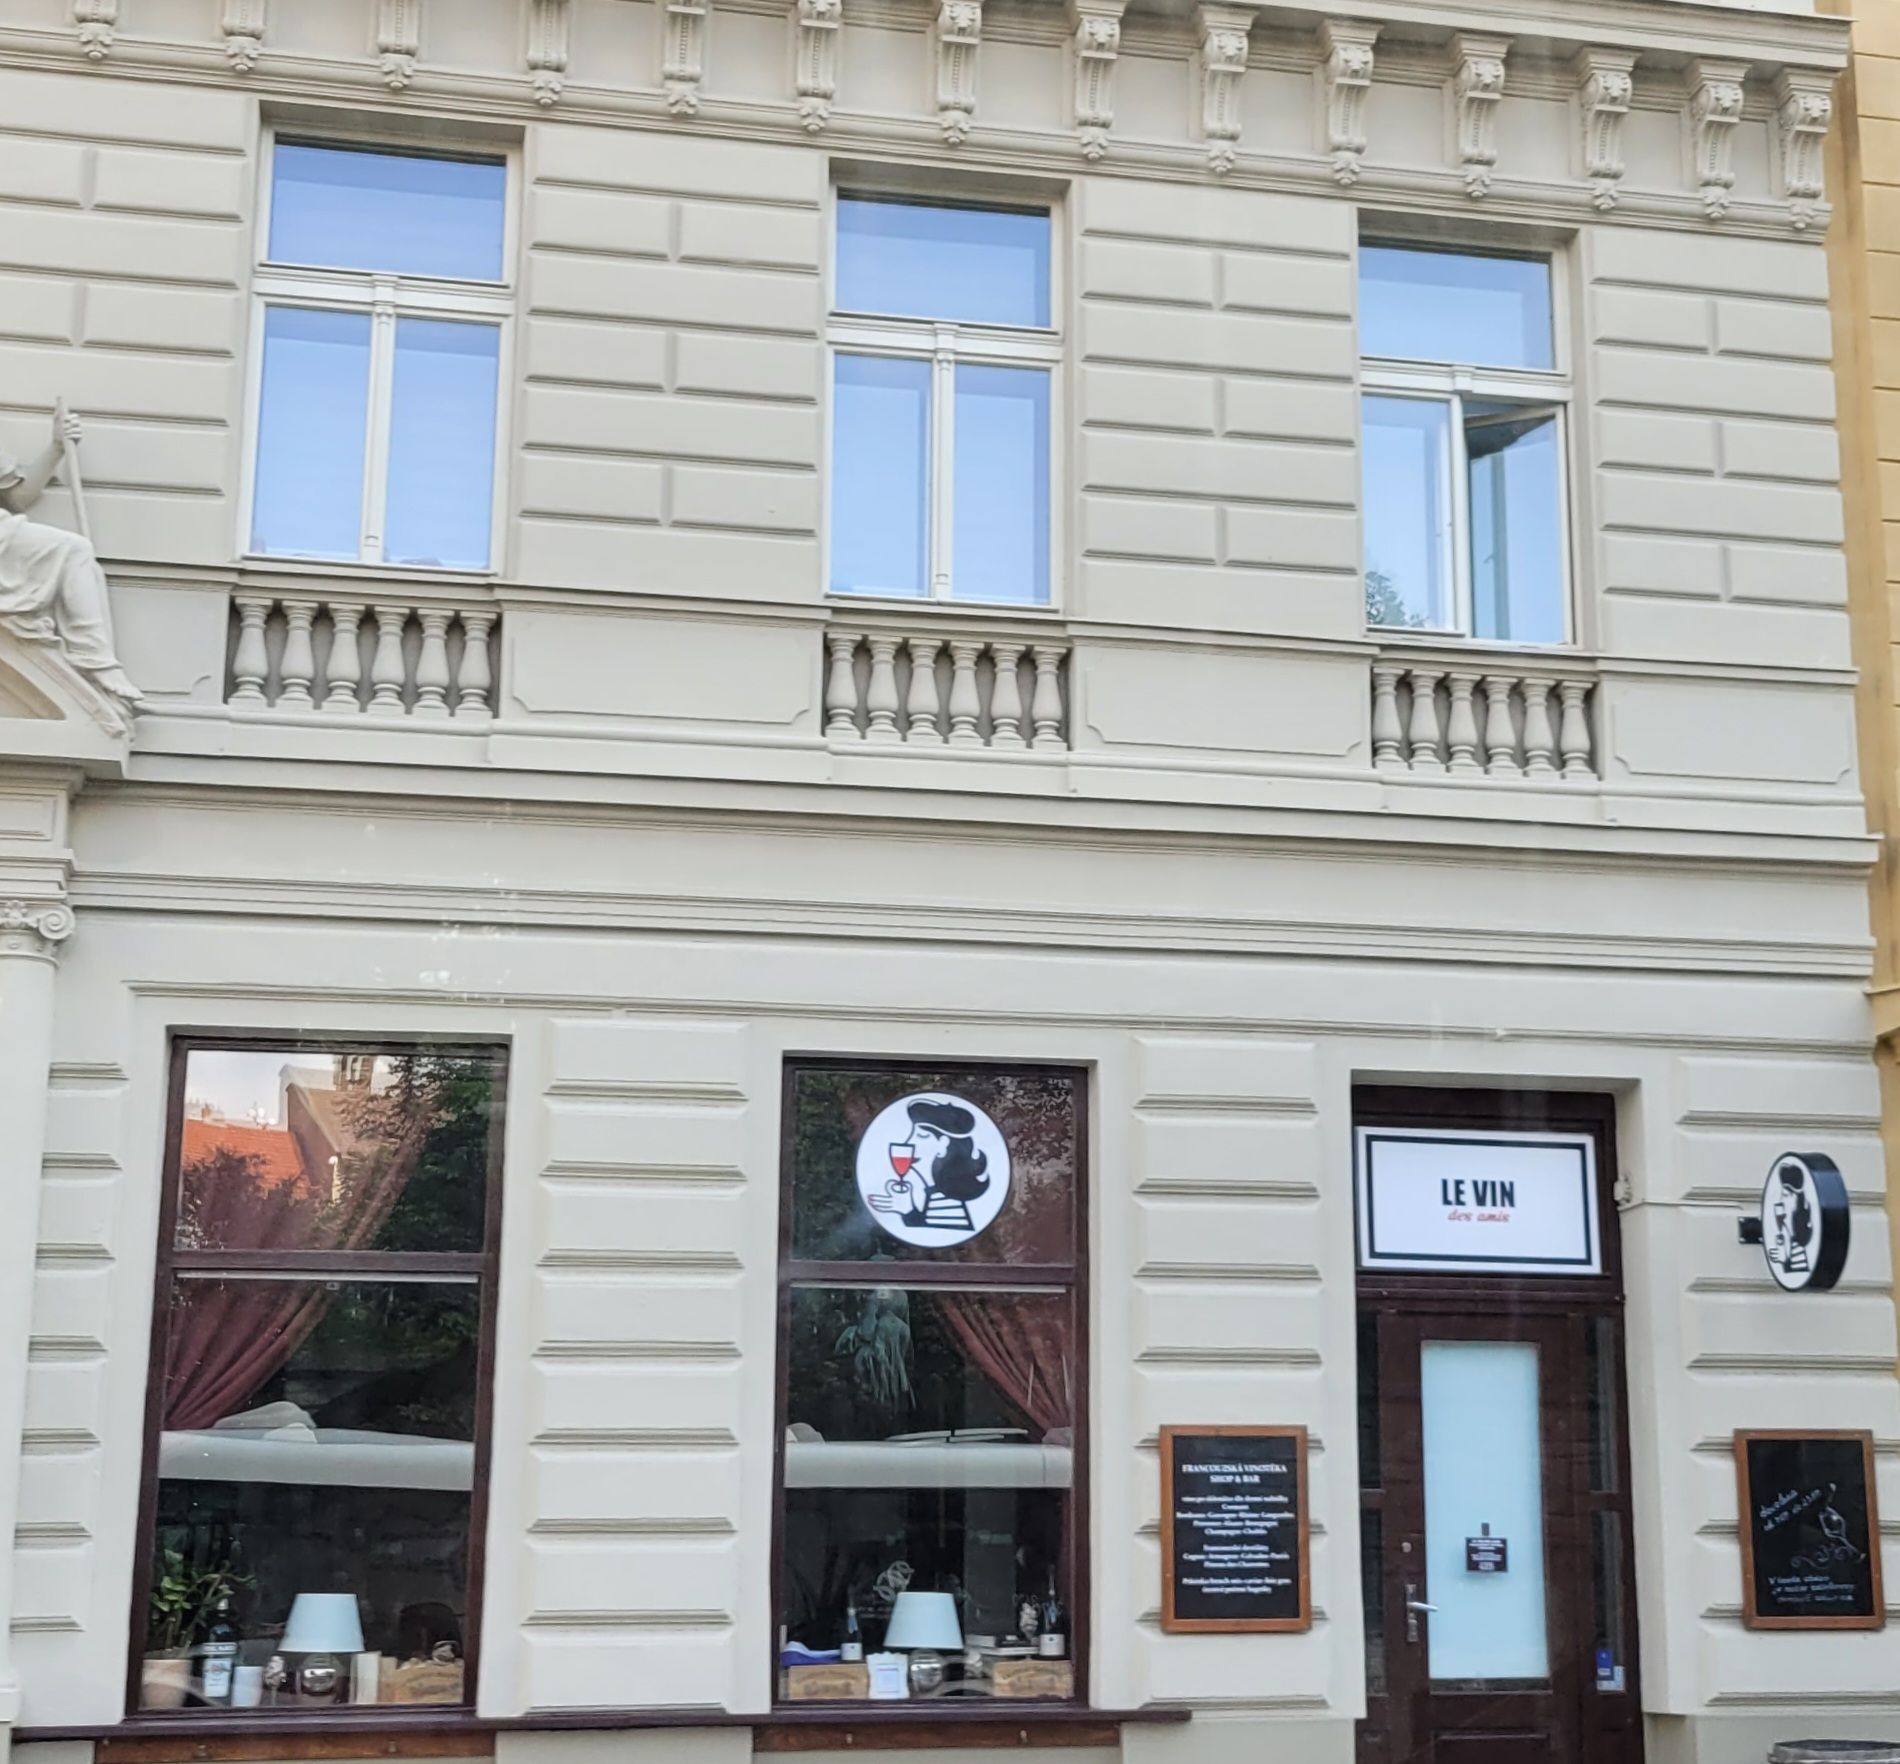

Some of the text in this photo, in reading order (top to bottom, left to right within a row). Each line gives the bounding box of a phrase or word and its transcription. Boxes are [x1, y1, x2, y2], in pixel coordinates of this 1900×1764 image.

[1441, 1178, 1515, 1207] LE VIN
[1447, 1209, 1510, 1223] des amis
[1209, 1475, 1234, 1483] SHOP
[1242, 1475, 1261, 1483] BAR
